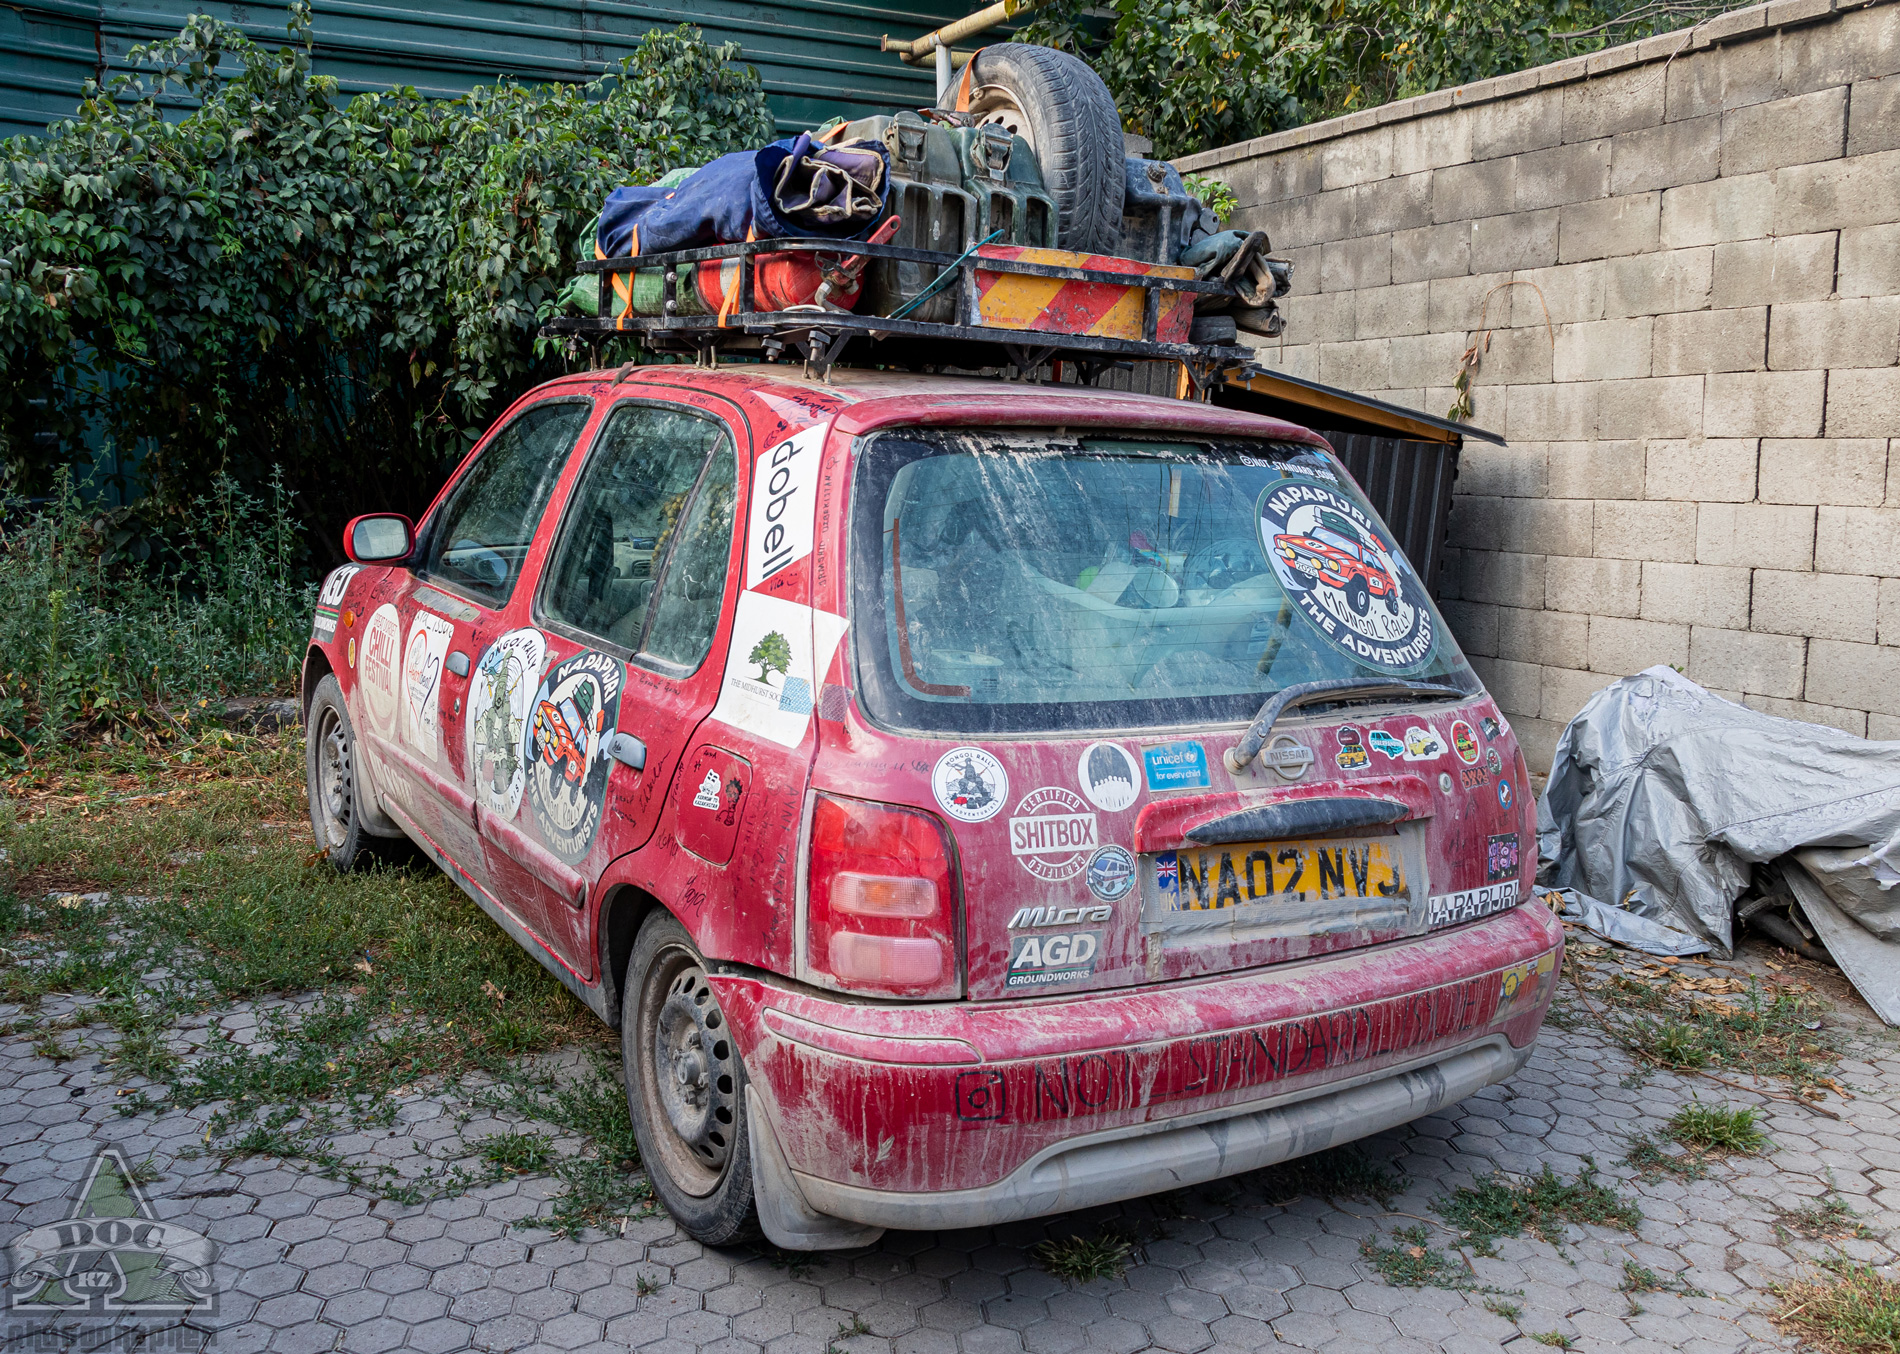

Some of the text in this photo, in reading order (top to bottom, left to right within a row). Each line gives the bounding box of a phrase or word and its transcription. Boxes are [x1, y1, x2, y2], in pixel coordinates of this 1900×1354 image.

[762, 440, 804, 579] dobell
[1268, 486, 1373, 530] NAPAPIJRI
[1296, 561, 1317, 576] 2025
[1323, 590, 1410, 640] MONGOL RALLY
[1299, 593, 1431, 665] THE ADVENTURISTS
[369, 626, 394, 670] CHILLI
[482, 637, 538, 671] MONGOL RALLY
[365, 654, 392, 697] FESTIVAL
[557, 654, 621, 704] NAPAPIJRI
[730, 678, 741, 687] THE
[741, 681, 769, 699] MIDHURST
[945, 752, 973, 767] MONGOL
[976, 754, 995, 768] RALLY
[1152, 752, 1184, 765] unicef
[1270, 749, 1309, 762] NISSAN
[1156, 769, 1201, 780] for every child
[1462, 766, 1488, 781] AWAY
[1464, 775, 1489, 788] DAYS
[528, 763, 598, 854] THE ADVENTURISTS
[956, 799, 999, 817] ADVENTURISTS
[1022, 789, 1080, 812] CERTIFIED
[1014, 818, 1095, 849] SHITBOX
[1109, 847, 1127, 857] RALLY
[1028, 855, 1085, 879] CERTIFIED
[1007, 904, 1112, 930] Micra
[1012, 933, 1096, 969] AGD
[1009, 970, 1090, 986] GROUNDWORKS
